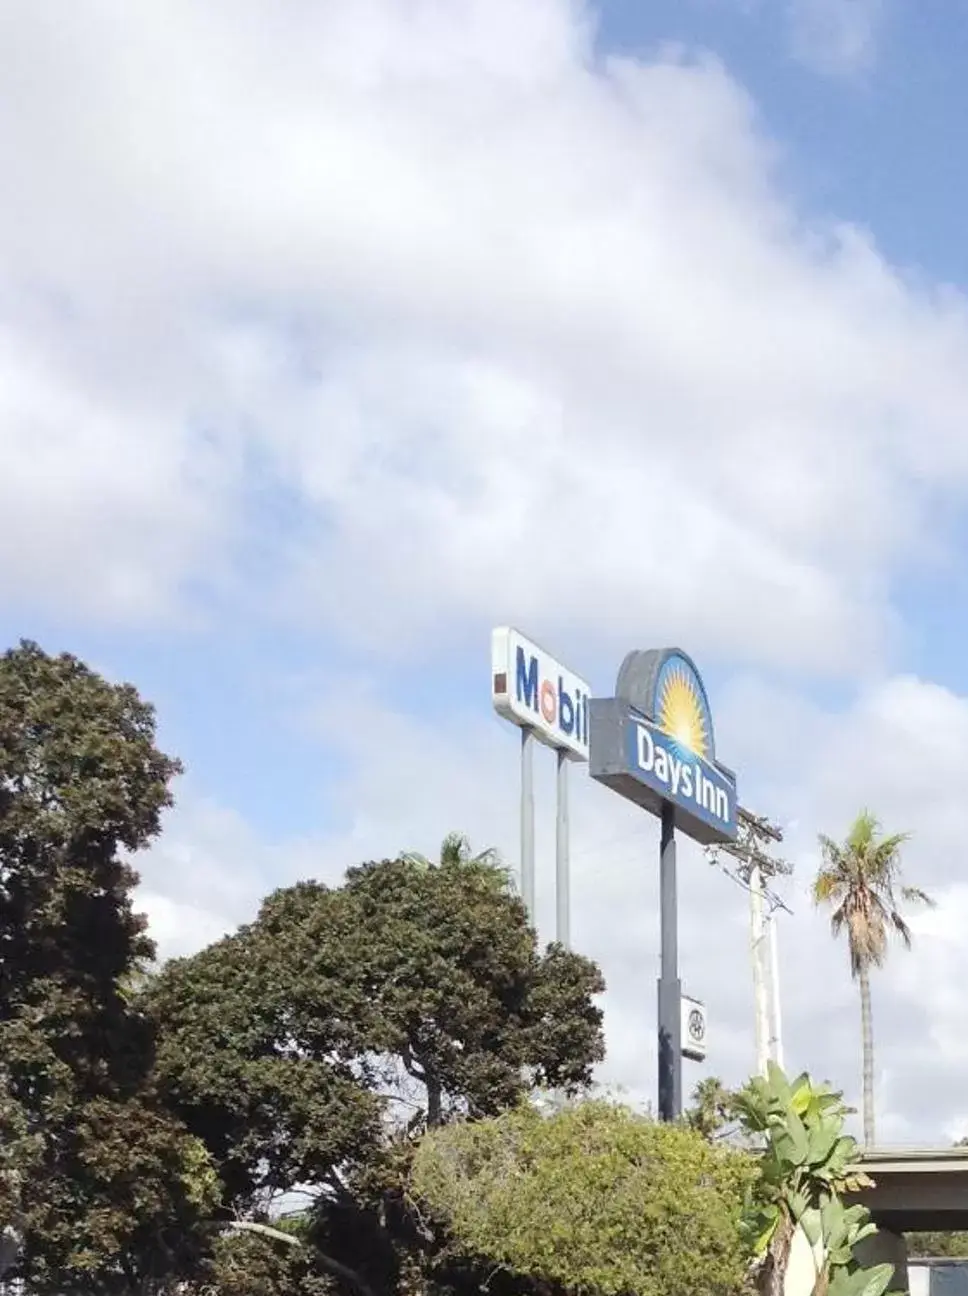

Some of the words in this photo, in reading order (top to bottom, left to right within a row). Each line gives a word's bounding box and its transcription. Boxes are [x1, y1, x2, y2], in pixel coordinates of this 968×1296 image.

[516, 645, 588, 747] Mobil
[637, 724, 692, 797] Days
[695, 762, 729, 823] Inn
